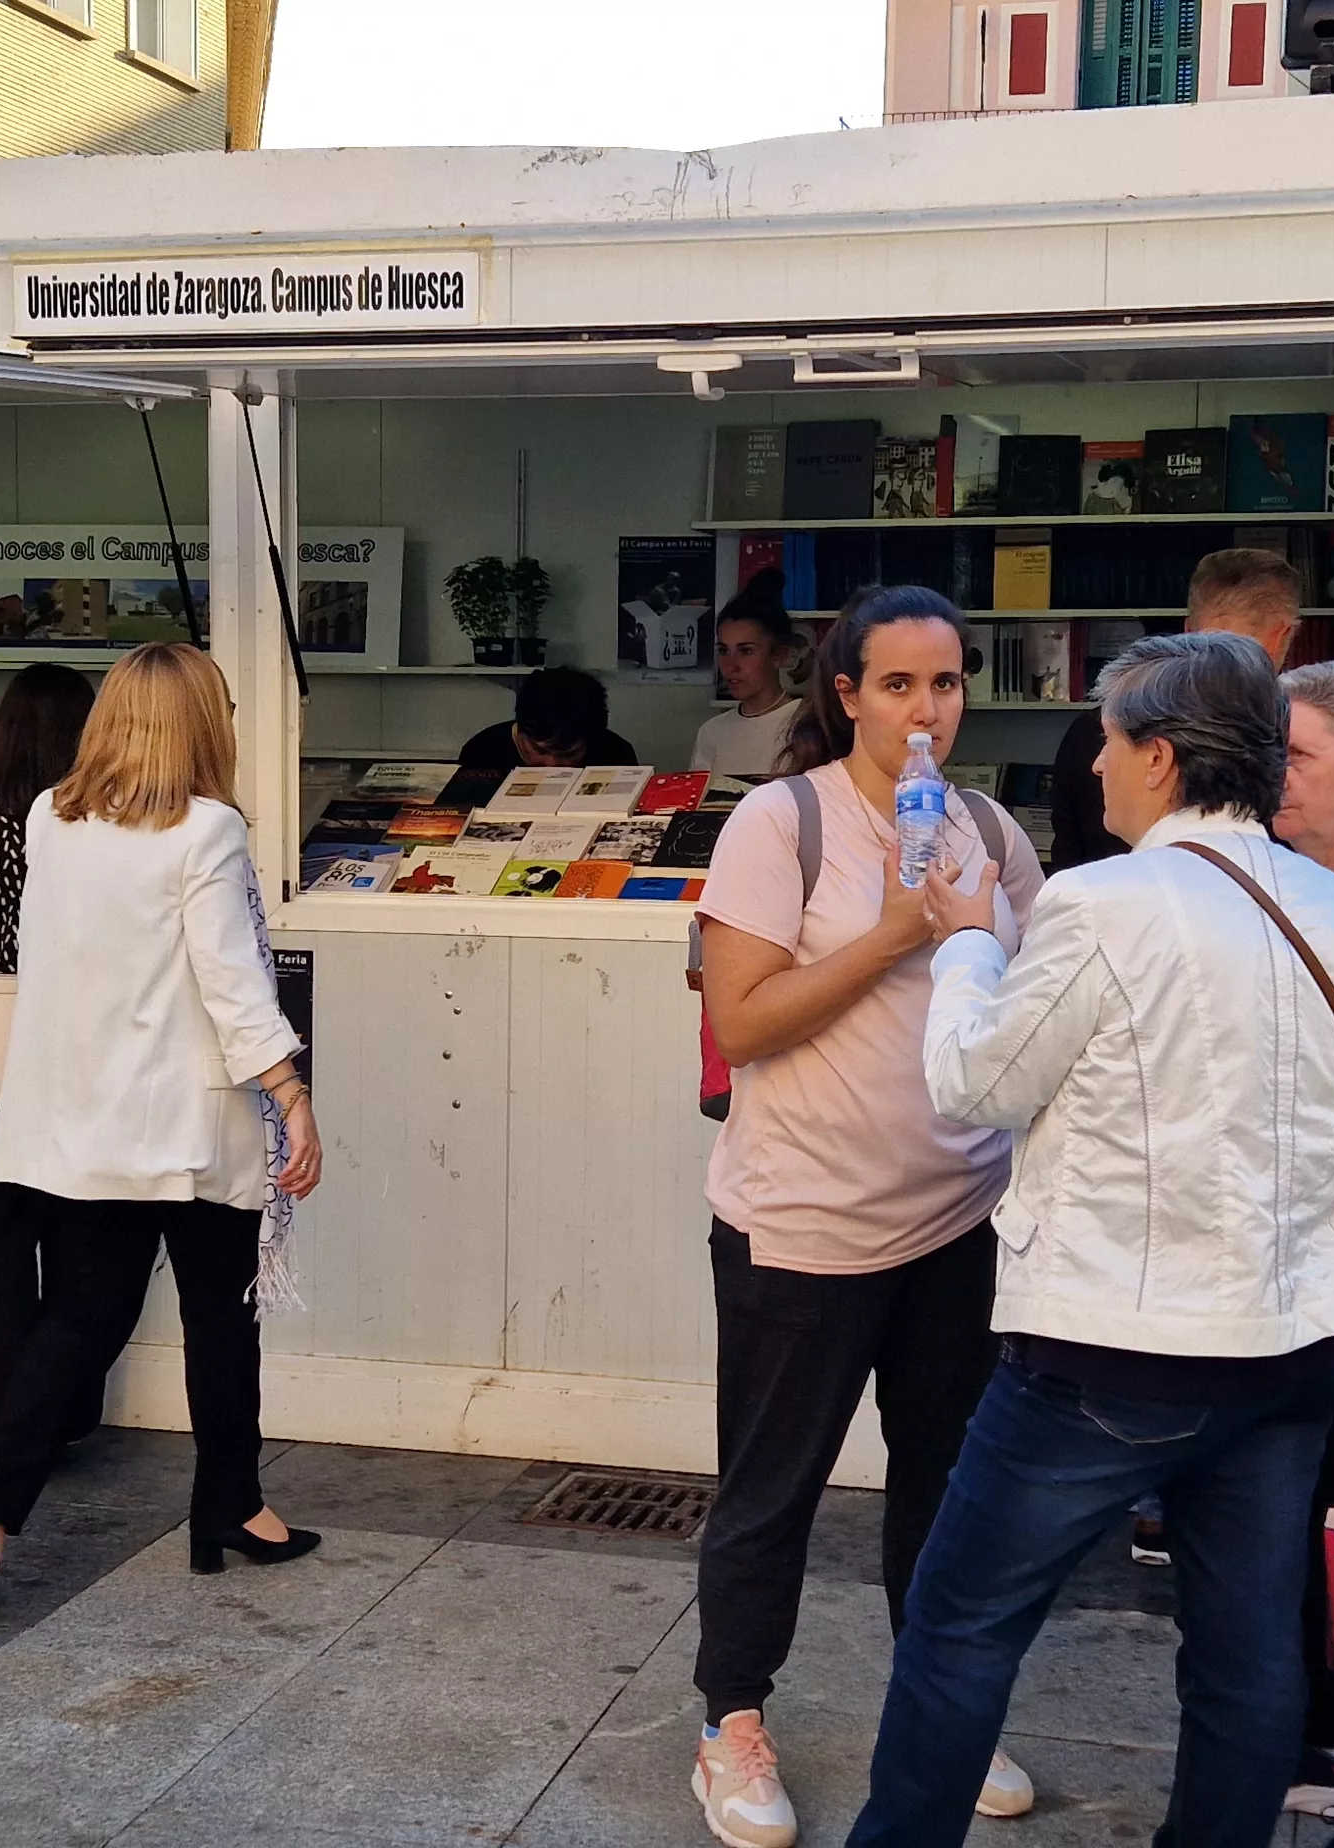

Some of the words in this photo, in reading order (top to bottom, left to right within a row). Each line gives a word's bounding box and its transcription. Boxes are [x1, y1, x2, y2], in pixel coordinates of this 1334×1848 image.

[27, 272, 140, 319] Universidad
[146, 272, 169, 317] de
[175, 271, 267, 319] Zaragoza.
[271, 267, 352, 317] Campus
[358, 266, 382, 312] de
[388, 265, 463, 310] Huesca
[1167, 453, 1202, 467] Elisa
[70, 536, 95, 560] el
[101, 537, 210, 566] Campus
[298, 540, 376, 563] esca?
[335, 861, 367, 873] LOS
[278, 953, 308, 965] Feria
